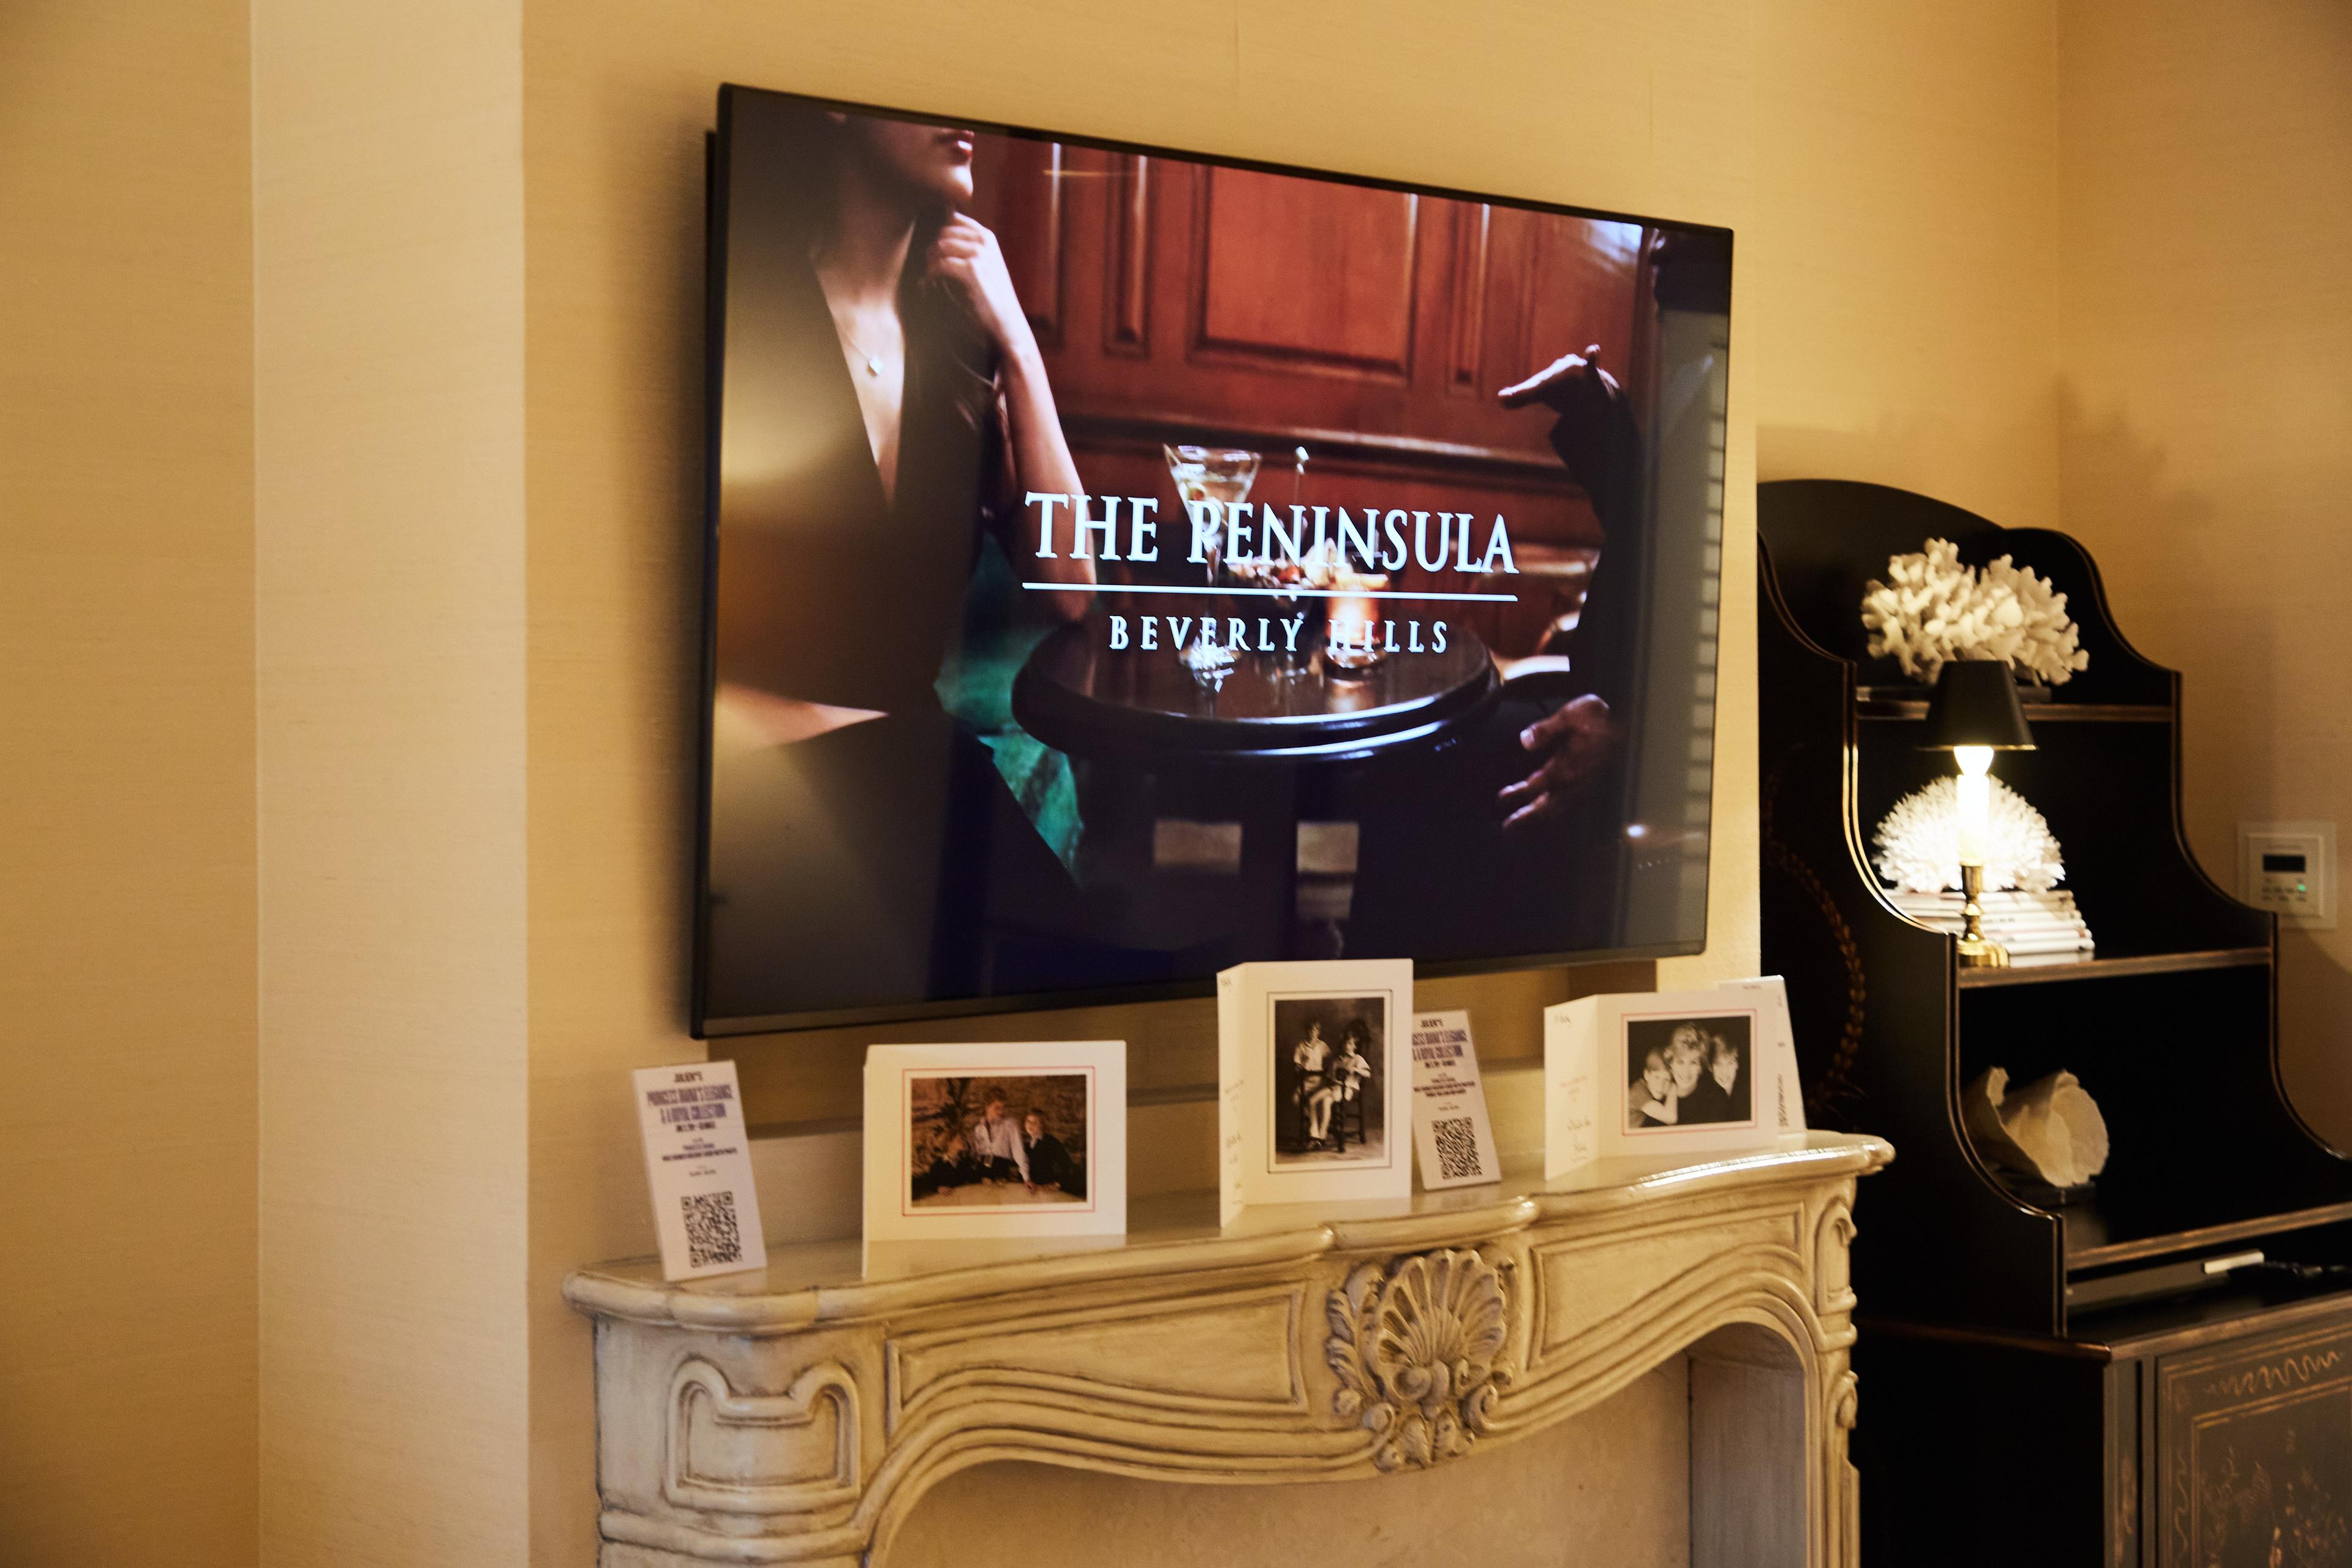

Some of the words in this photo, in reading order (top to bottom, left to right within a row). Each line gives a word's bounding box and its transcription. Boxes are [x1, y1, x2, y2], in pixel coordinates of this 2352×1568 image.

[1024, 491, 1159, 563] THE
[1186, 499, 1520, 575] PENINSULA
[1109, 615, 1304, 652] BEVERLY
[1329, 619, 1449, 654] HILLS
